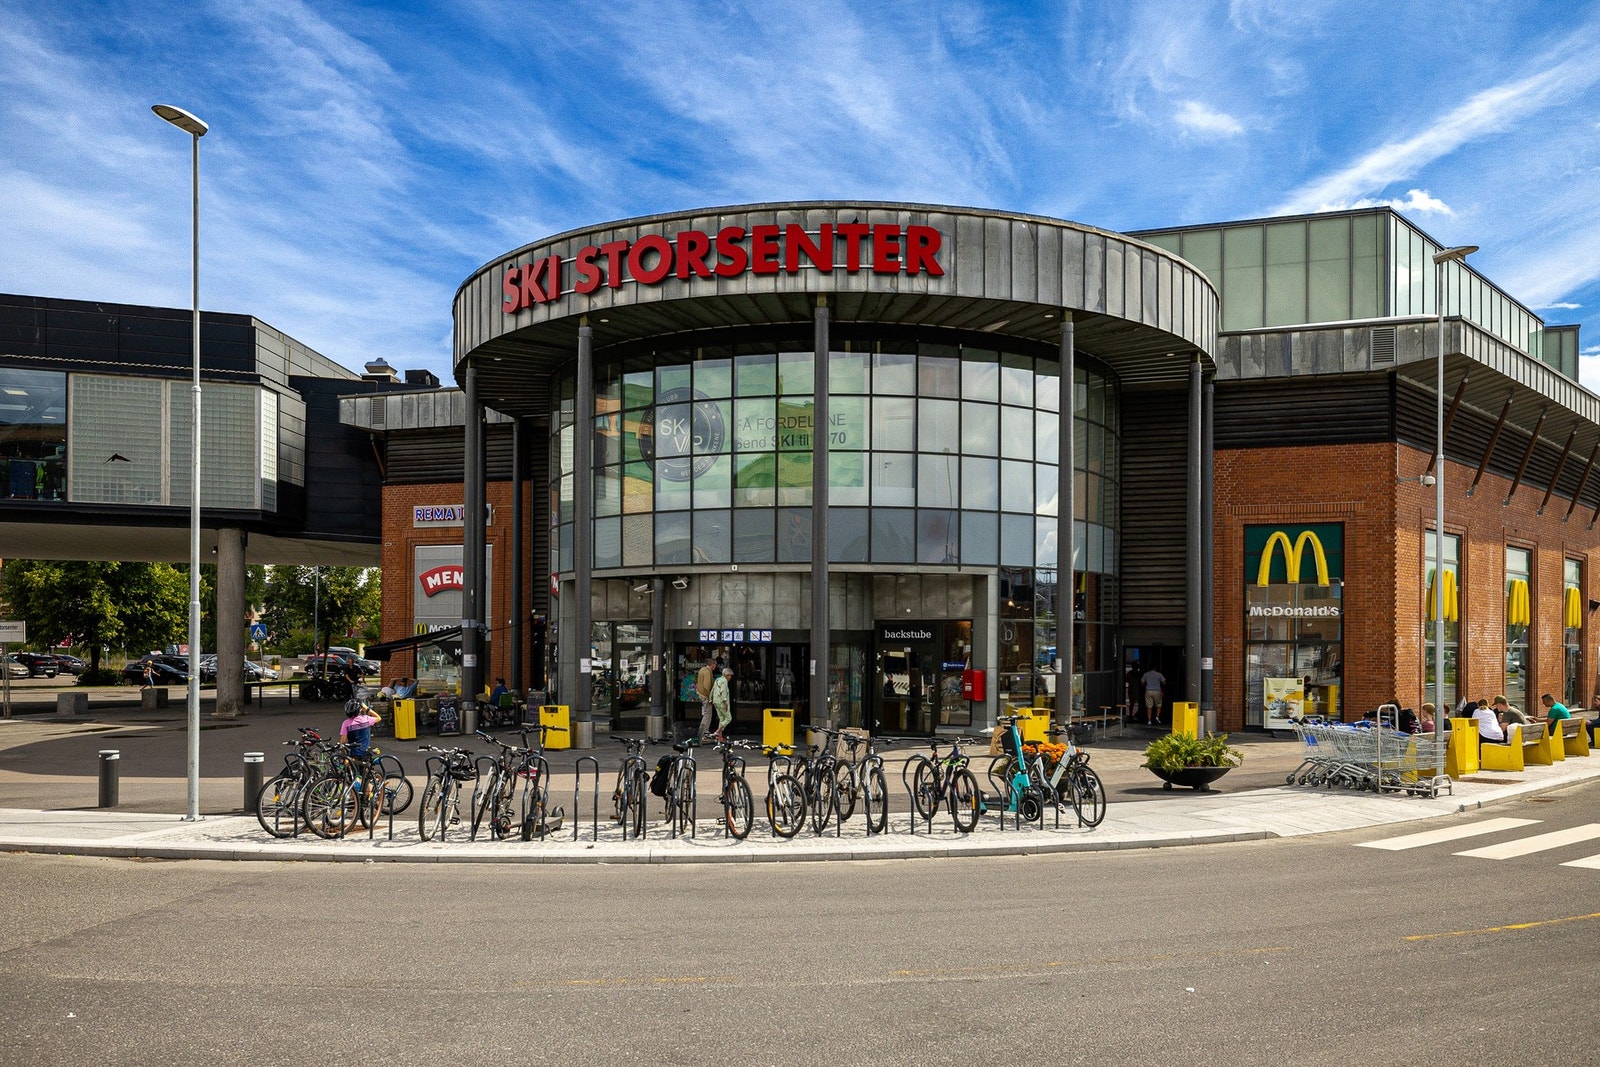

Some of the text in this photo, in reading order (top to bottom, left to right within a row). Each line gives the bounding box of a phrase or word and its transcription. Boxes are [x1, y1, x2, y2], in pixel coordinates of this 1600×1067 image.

[501, 222, 945, 314] SKI STORSENTER
[756, 413, 846, 431] FORDELNE
[415, 507, 455, 520] REMA
[426, 571, 464, 589] MEN
[1249, 606, 1340, 617] McDonald's
[884, 629, 932, 639] backstube
